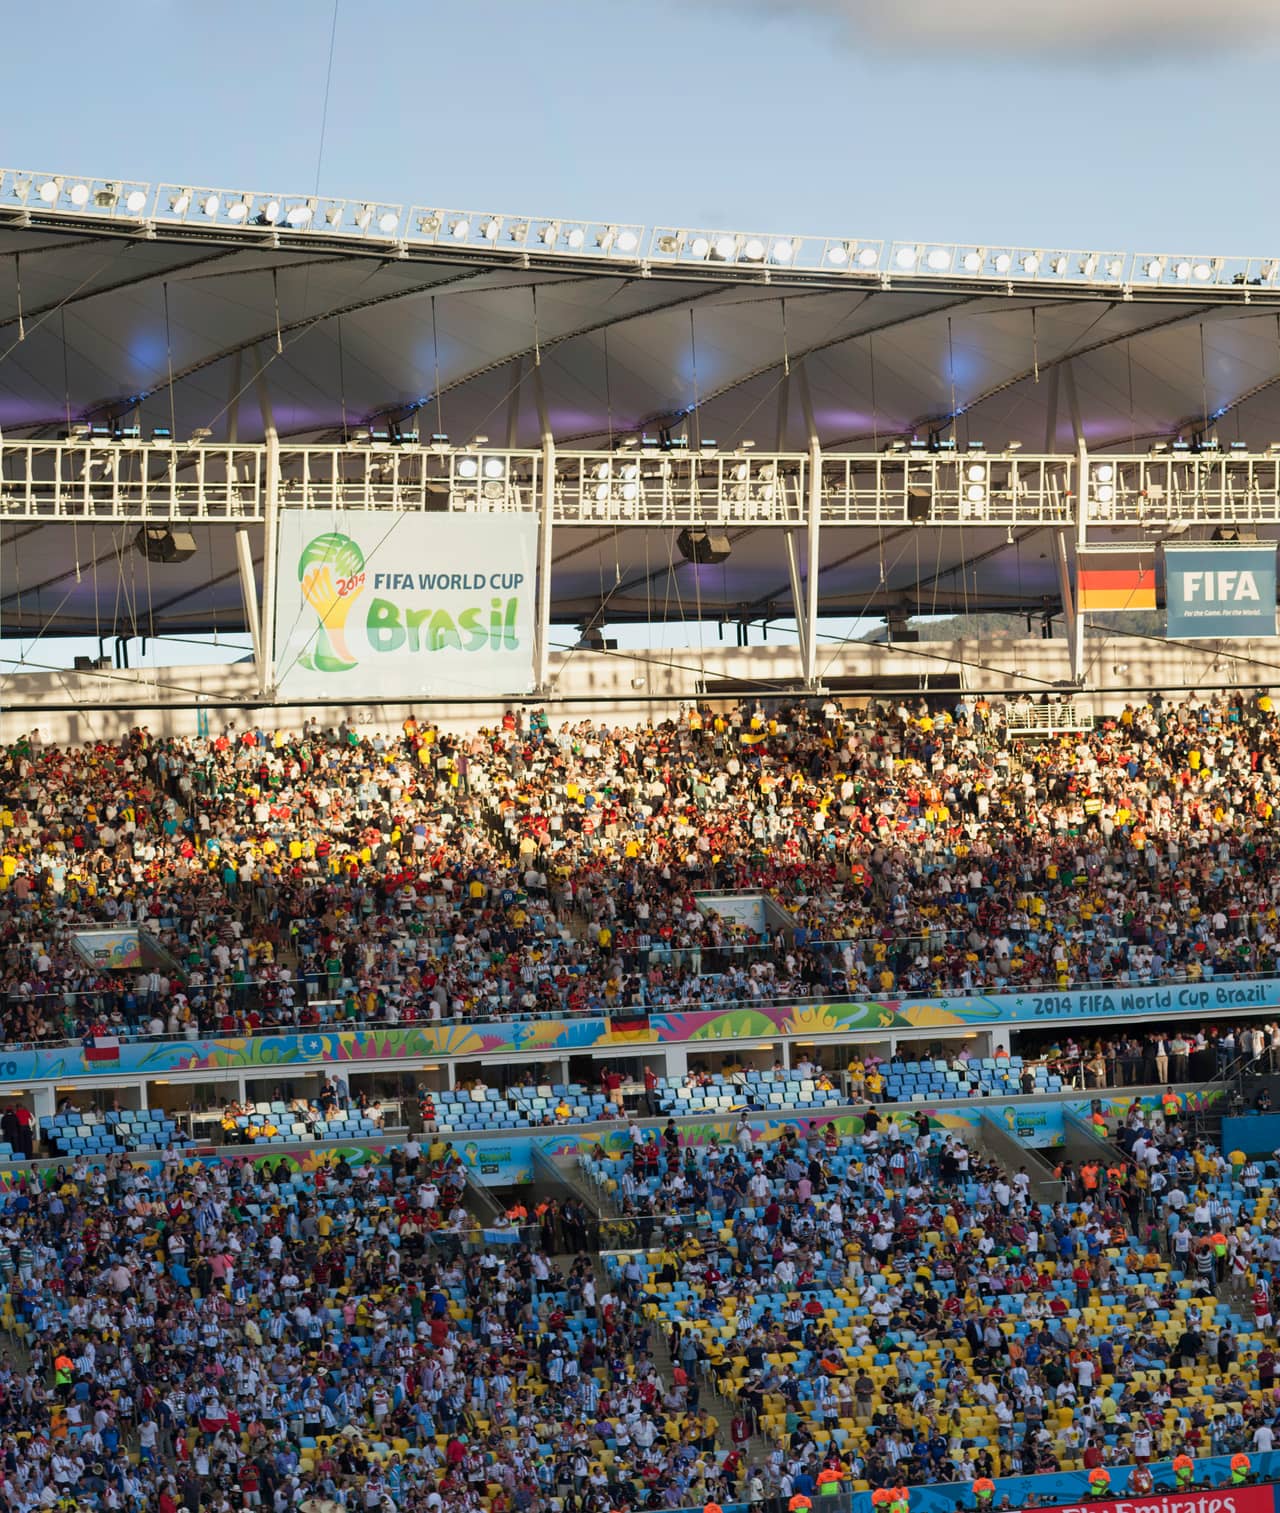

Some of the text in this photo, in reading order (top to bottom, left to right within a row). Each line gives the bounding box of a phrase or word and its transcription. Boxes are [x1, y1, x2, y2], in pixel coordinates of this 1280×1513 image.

[336, 572, 366, 596] 2014
[374, 572, 524, 591] FIFA WORLD CUP
[1183, 571, 1260, 602] FIFA
[366, 597, 520, 652] Brasil
[358, 713, 373, 724] 32
[1032, 986, 1266, 1015] 2014 FIFA World Cup Brazil
